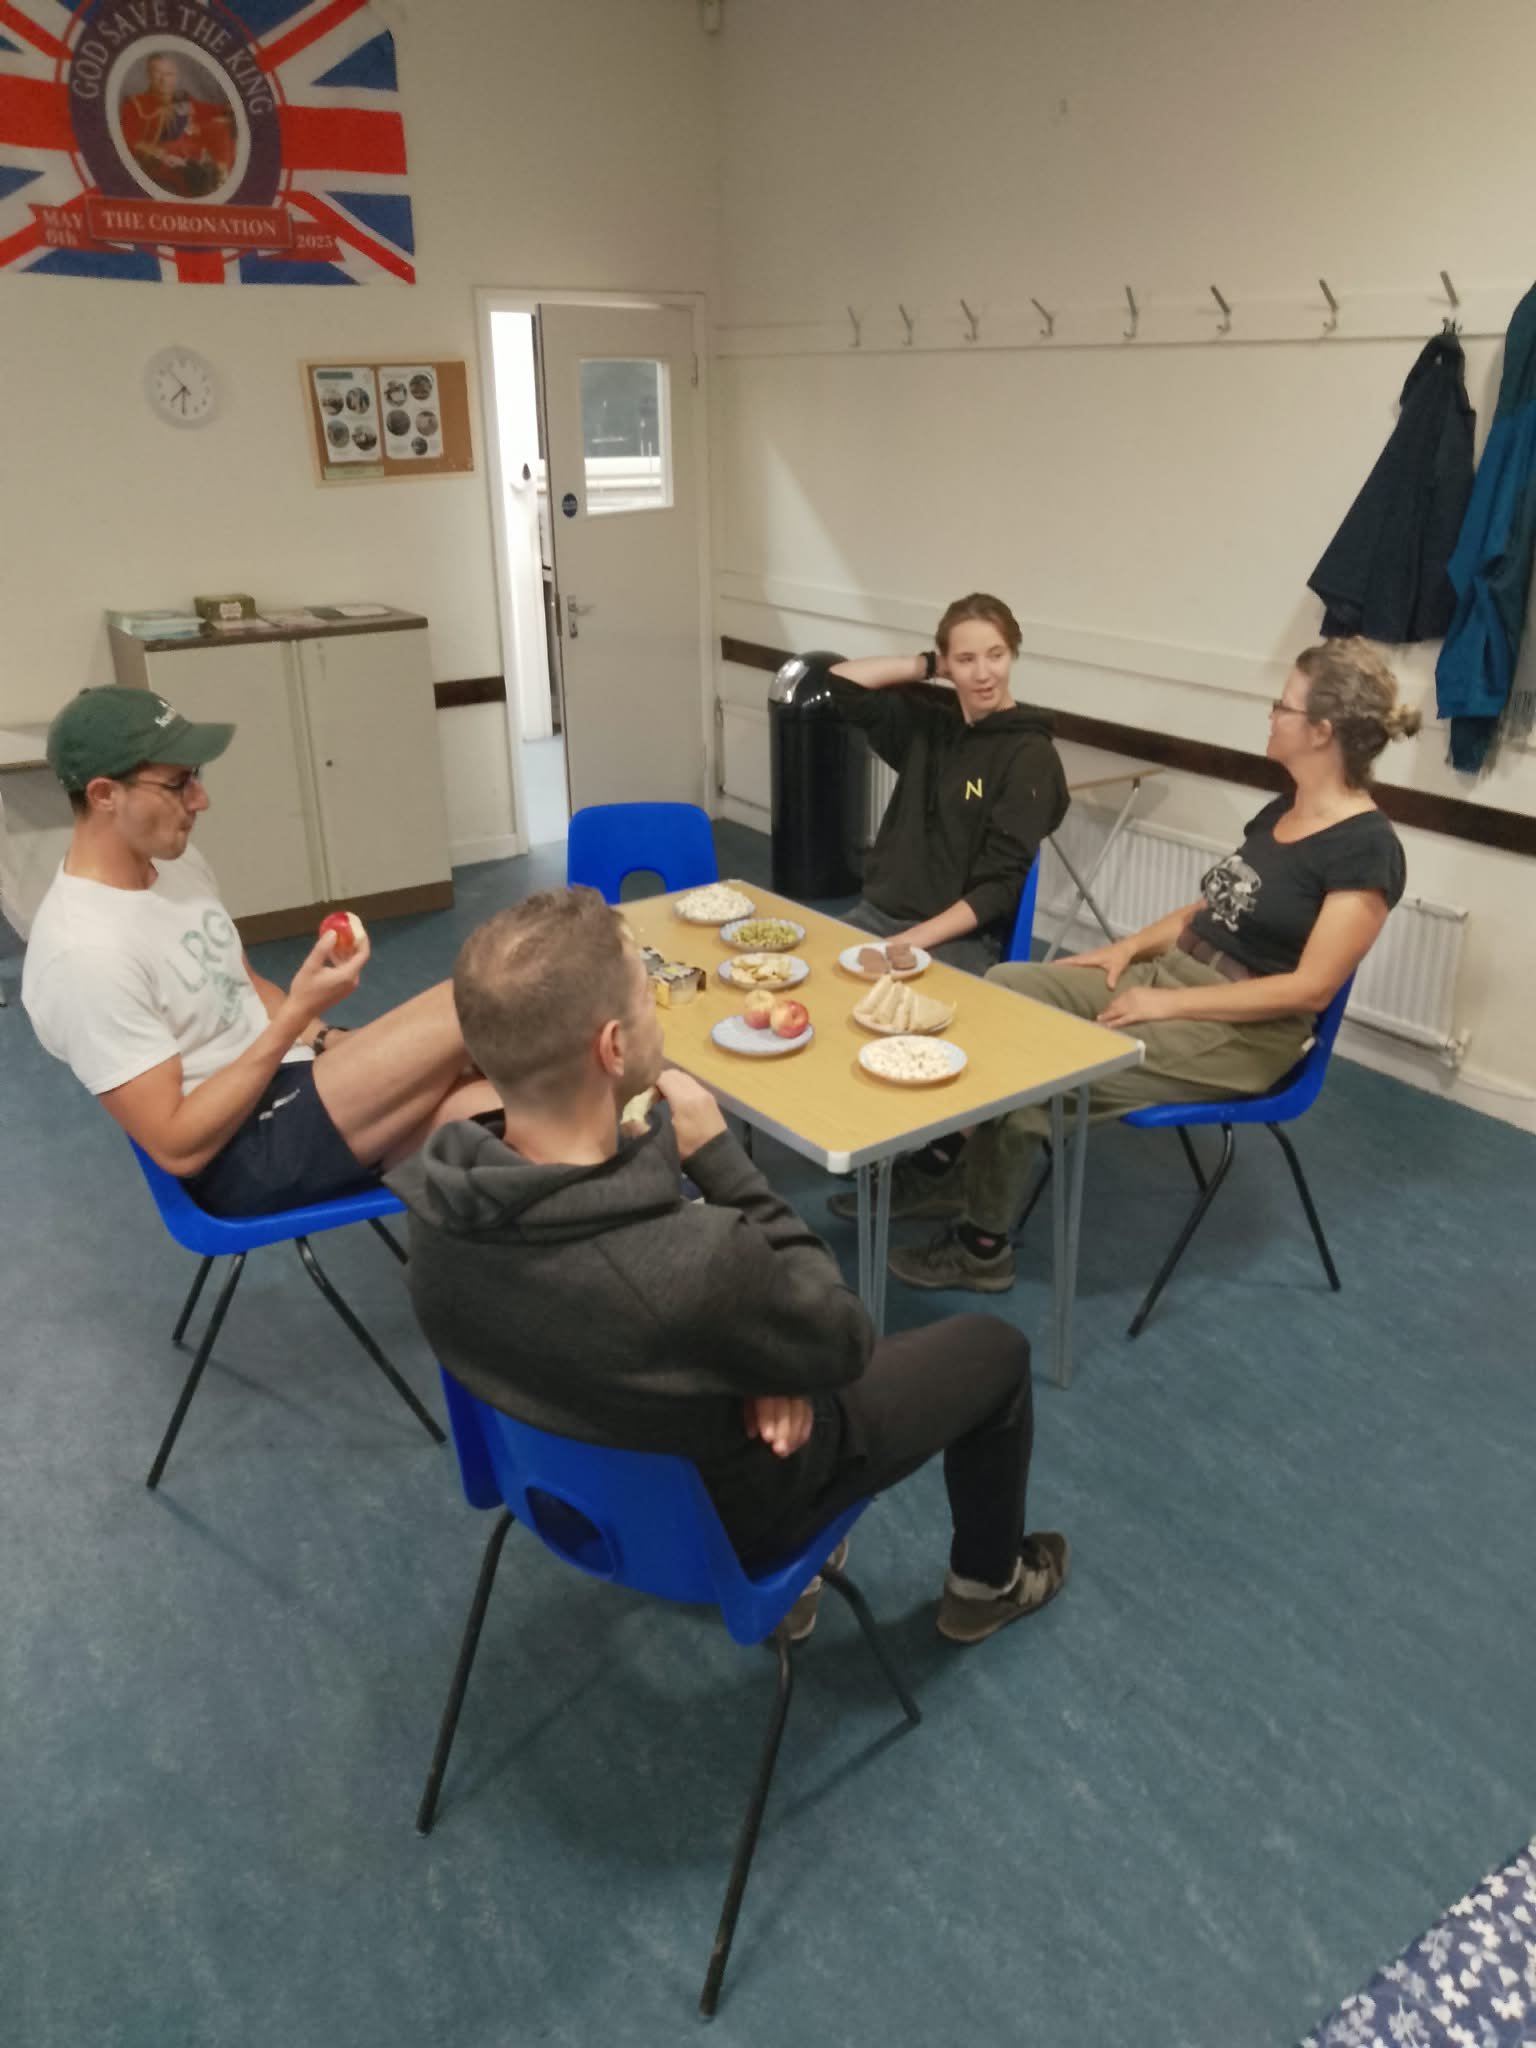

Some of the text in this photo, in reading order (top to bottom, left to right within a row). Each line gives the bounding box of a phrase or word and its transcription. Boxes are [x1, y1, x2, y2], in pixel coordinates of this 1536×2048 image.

[72, 0, 274, 115] GOD SAVE THE KING
[42, 209, 83, 230] MAY
[102, 209, 277, 238] THE CORONATION
[964, 778, 983, 800] N
